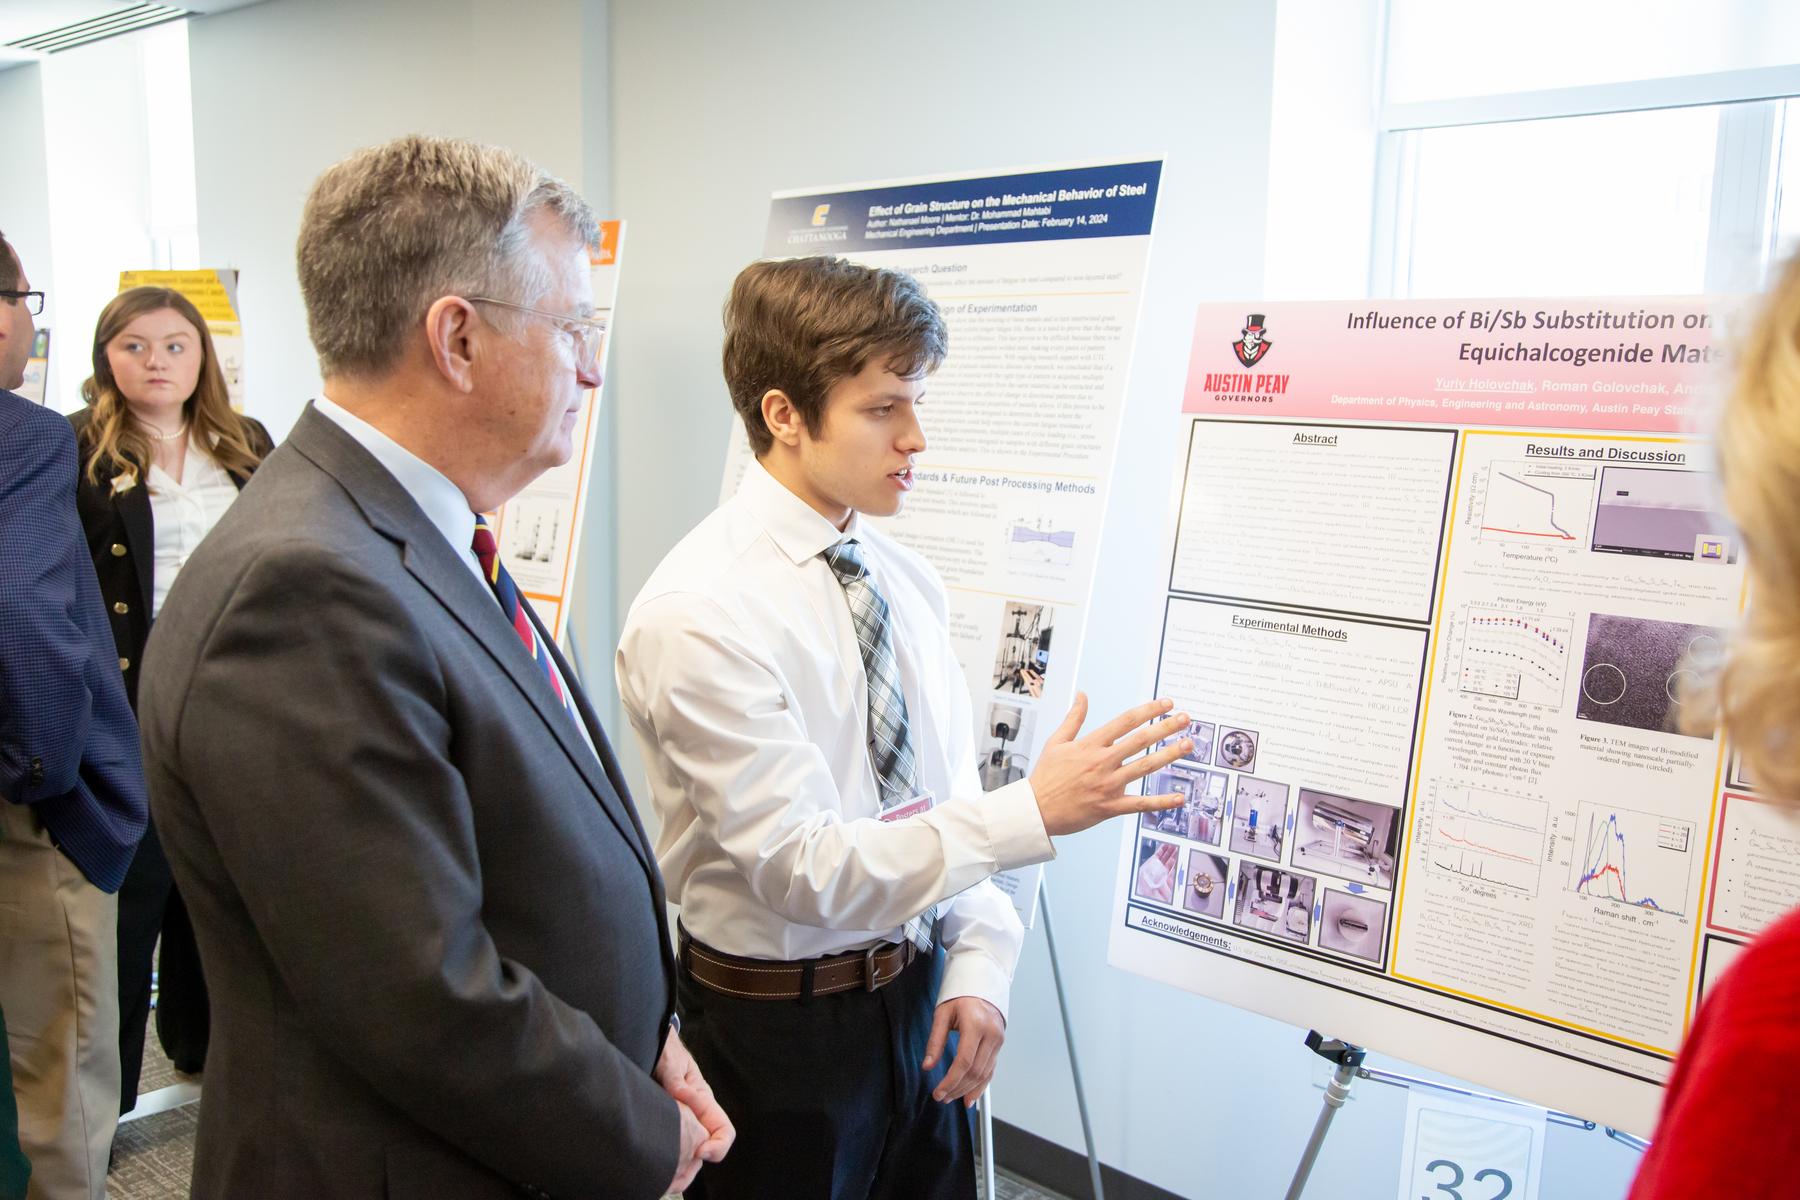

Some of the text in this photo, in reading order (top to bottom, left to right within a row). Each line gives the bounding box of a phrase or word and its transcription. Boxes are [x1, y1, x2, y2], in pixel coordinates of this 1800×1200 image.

[868, 183, 1147, 218] Effect of Grain Structure on the Mechanical Behavior of Steel
[920, 215, 941, 225] Moore
[945, 213, 969, 223] Mentor:
[970, 212, 981, 221] Dr.
[982, 208, 1022, 219] Mohammad
[865, 213, 1108, 240] Mechanical Engineering Department Presentation Date: February 14, 2024
[787, 230, 847, 244] CHATTANOOGA
[931, 264, 968, 274] Question
[957, 304, 966, 313] of
[967, 303, 1038, 315] Experimentation
[1347, 309, 1712, 333] Influence of Bi/Sb Substitution on
[1459, 342, 1654, 367] Equichalcogenide
[1204, 373, 1290, 394] AUSTIN PEAY
[1468, 378, 1537, 393] Holovchak,
[1542, 380, 1588, 392] Roman
[1592, 381, 1670, 395] Golovchak,
[1214, 395, 1274, 403] GOVERNORS
[1331, 395, 1384, 407] Department
[1386, 396, 1397, 406] of
[1398, 396, 1438, 409] Physics,
[1442, 398, 1502, 411] Engineering
[1505, 400, 1524, 410] and
[1527, 400, 1588, 414] Astronomy,
[1592, 402, 1628, 414] Austin
[1632, 403, 1660, 416] Peay
[1293, 432, 1338, 445] Abstract
[1525, 443, 1687, 463] Results and Discussion
[912, 471, 1096, 495] ndards & Future Post Processing Methods
[1502, 551, 1543, 562] Temperature
[1497, 596, 1516, 604] Photon
[1517, 599, 1535, 607] Energy
[1232, 614, 1349, 641] Experimental Methods
[1448, 710, 1468, 720] Figure
[1546, 726, 1558, 734] film
[1498, 708, 1528, 718] Wavelength
[1453, 720, 1478, 730] deposited
[1511, 730, 1536, 739] substrate
[1465, 739, 1484, 748] change
[1498, 745, 1521, 754] function
[1530, 750, 1555, 760] exposure
[1486, 733, 1499, 741] gold
[1531, 743, 1553, 751] relative
[1580, 733, 1601, 743] Figure
[1610, 738, 1626, 747] TEM
[1628, 742, 1649, 752] images
[1651, 746, 1660, 754] of
[1660, 747, 1699, 759] Bi-modified
[1447, 745, 1479, 756] wavelength,
[1480, 751, 1507, 761] measured
[1580, 744, 1605, 754] material
[1606, 747, 1631, 758] showing
[1634, 752, 1665, 763] nanoscale
[1597, 755, 1620, 765] ordered
[1621, 760, 1644, 770] regions
[1452, 755, 1471, 764] voltage
[1484, 761, 1507, 769] constant
[1509, 764, 1529, 774] photon
[1482, 767, 1504, 777] photons
[1546, 833, 1557, 862] Intensity
[1473, 888, 1497, 899] degrees
[1593, 906, 1620, 919] Raman
[1621, 913, 1637, 923] shift
[1141, 914, 1232, 950] Acknowledgements:
[1422, 1159, 1513, 1200] 32
